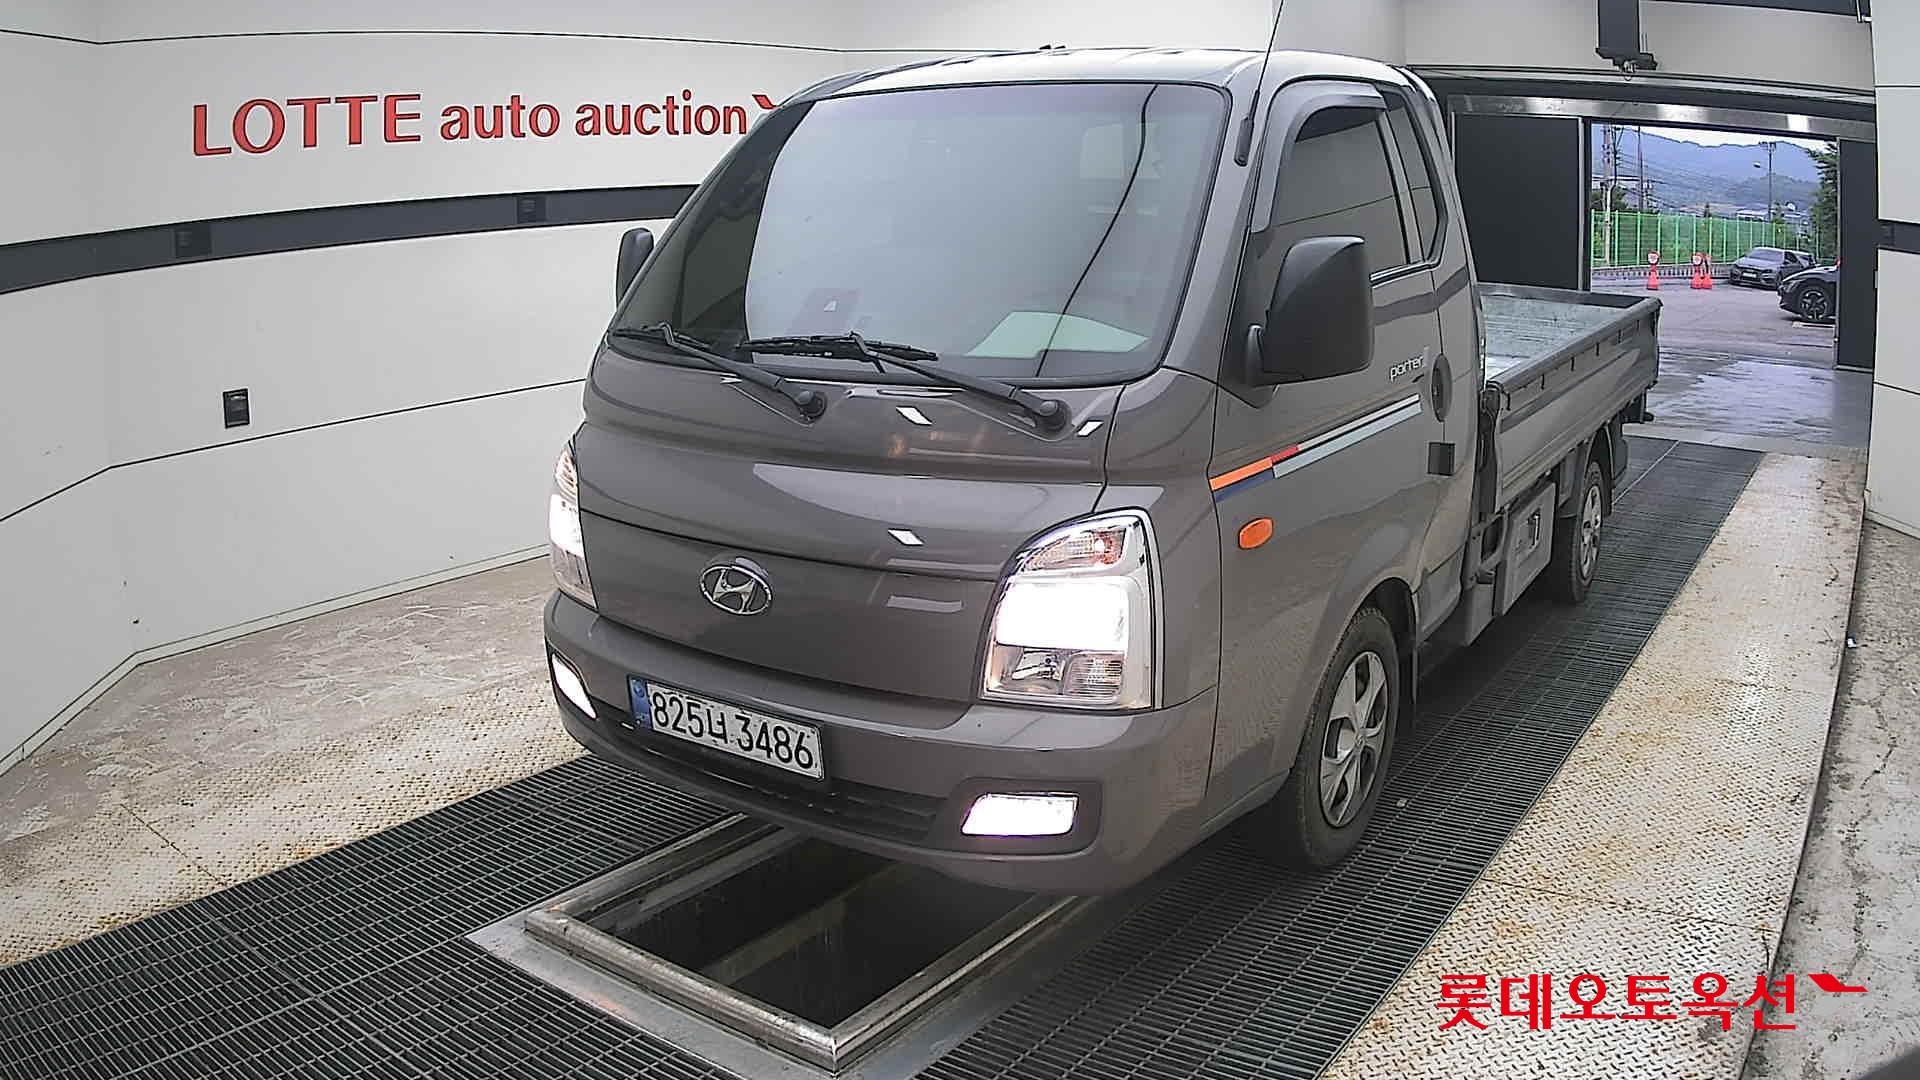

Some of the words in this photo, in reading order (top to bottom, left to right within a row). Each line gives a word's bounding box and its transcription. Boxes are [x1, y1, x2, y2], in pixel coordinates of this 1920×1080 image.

[192, 94, 422, 157] LOTTE
[440, 94, 561, 140] auto
[575, 88, 748, 136] auction
[1390, 355, 1424, 382] porter
[735, 712, 814, 770] 3486
